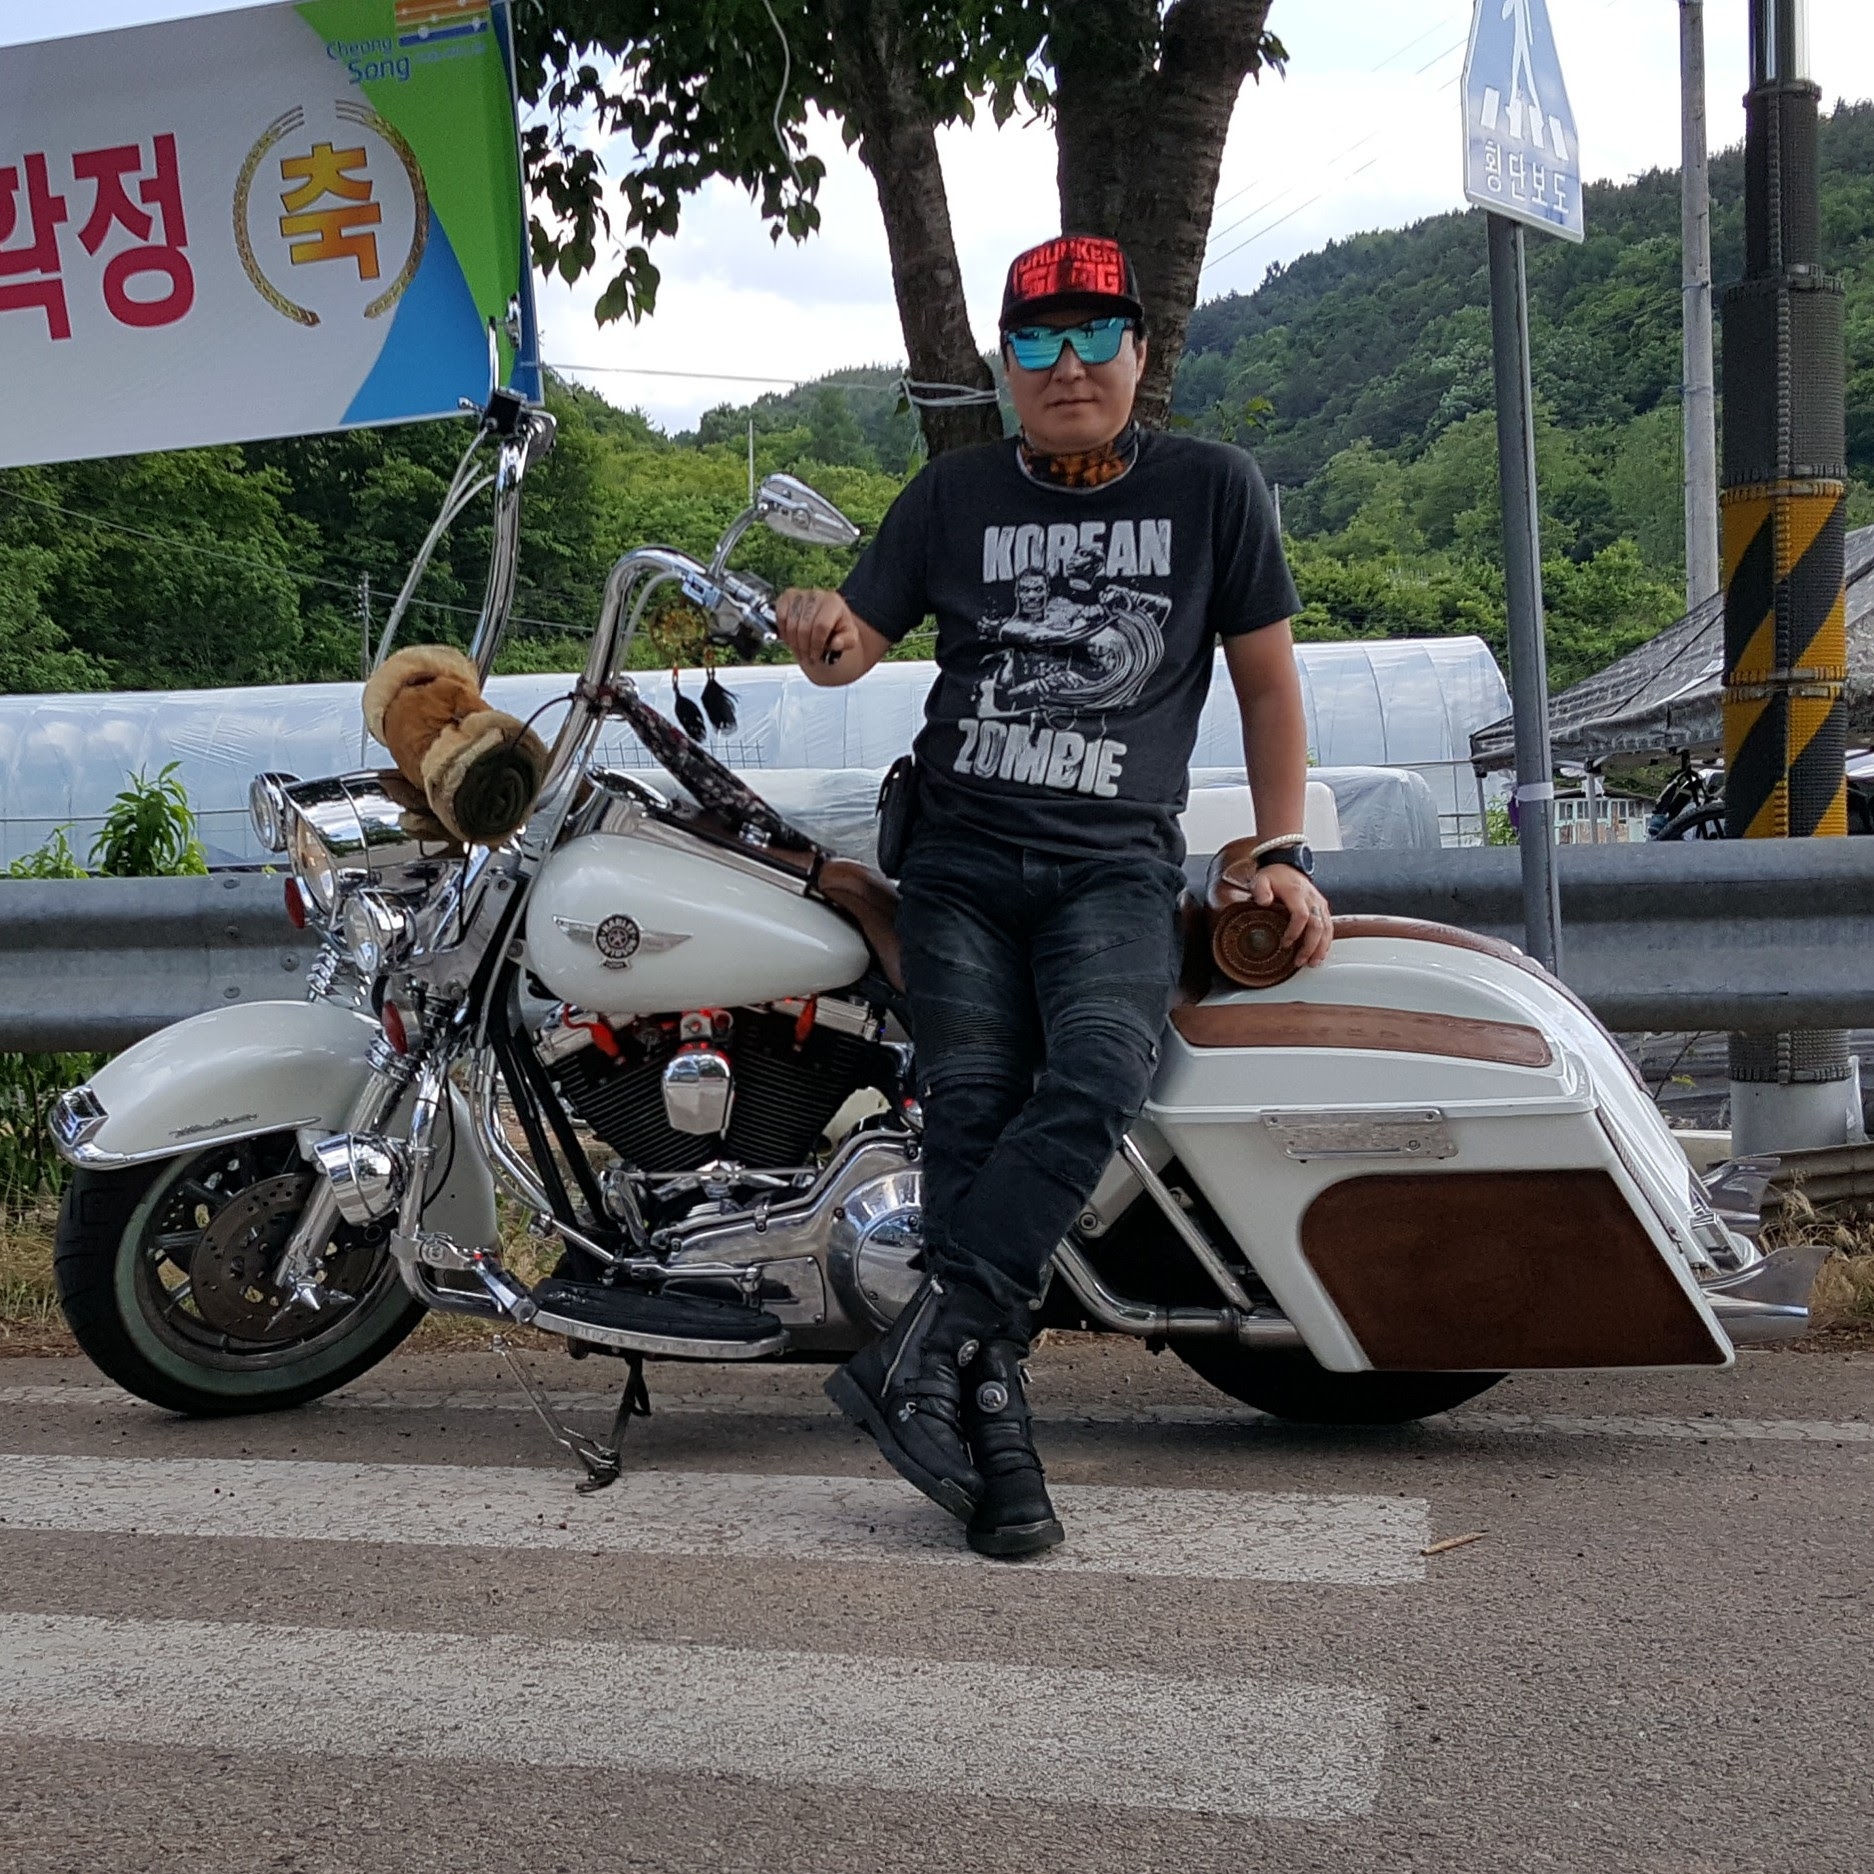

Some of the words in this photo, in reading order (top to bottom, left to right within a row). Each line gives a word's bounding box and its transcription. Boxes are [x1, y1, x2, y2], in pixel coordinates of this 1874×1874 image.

[326, 37, 393, 61] Cheong
[348, 56, 410, 85] Song
[279, 142, 382, 281] 축
[1485, 140, 1569, 214] 횡단보도
[982, 518, 1172, 583] KOREAN
[952, 718, 1127, 798] ZOMBIE
